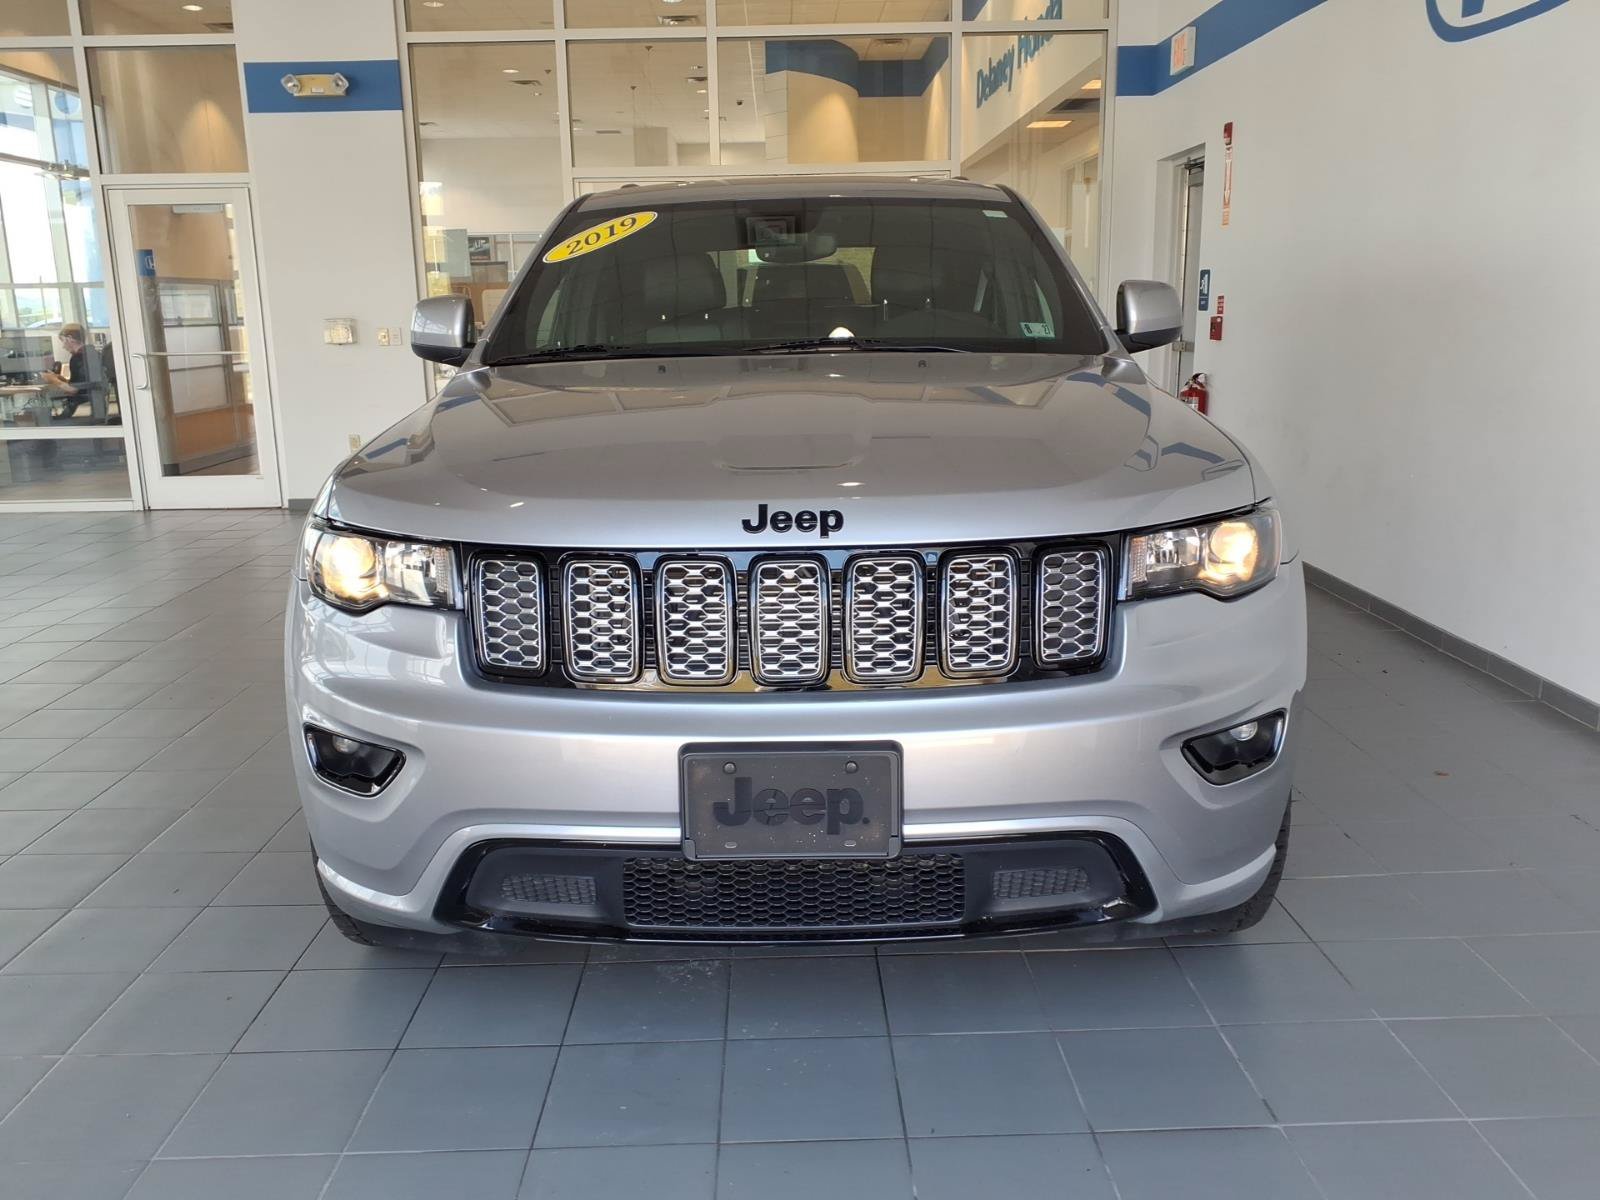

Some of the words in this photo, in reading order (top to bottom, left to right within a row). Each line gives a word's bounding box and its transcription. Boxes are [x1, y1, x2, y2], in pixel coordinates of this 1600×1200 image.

[977, 44, 1014, 108] Delaney
[566, 216, 637, 256] 2019
[741, 503, 844, 538] Jeep
